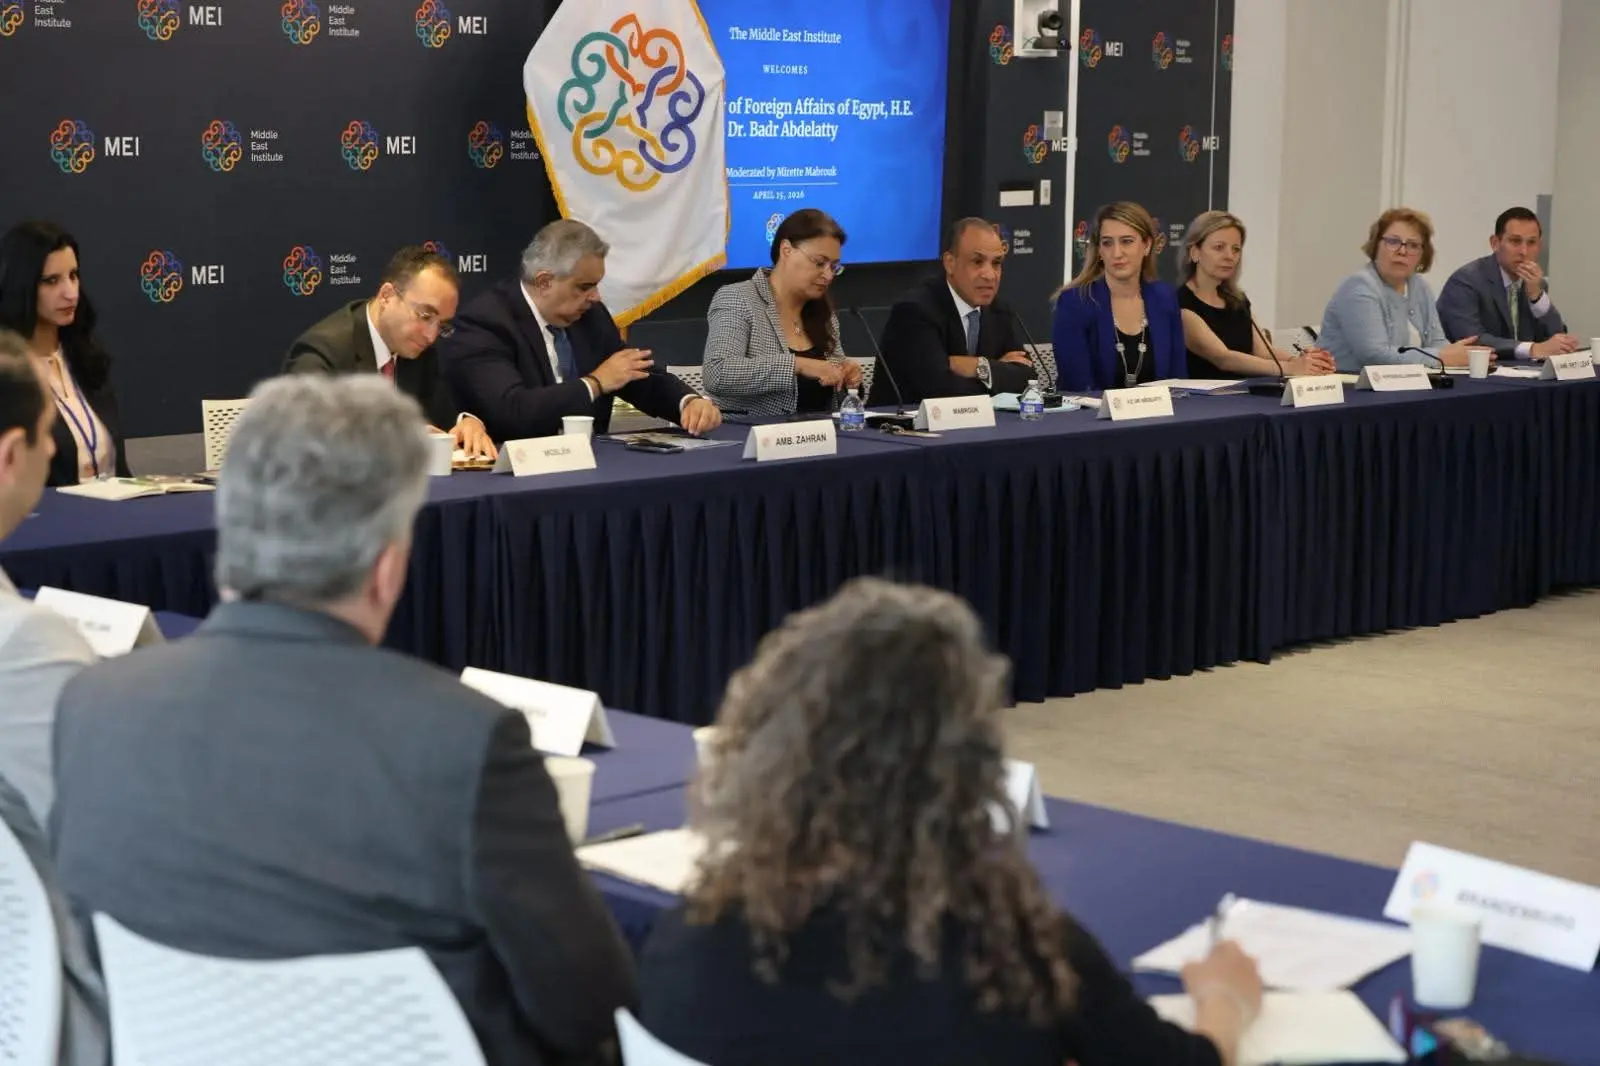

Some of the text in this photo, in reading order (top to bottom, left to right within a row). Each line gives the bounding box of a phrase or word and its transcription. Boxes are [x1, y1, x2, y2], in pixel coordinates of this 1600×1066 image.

[34, 5, 54, 15] East
[328, 5, 355, 15] Middle
[189, 6, 222, 26] MEI
[328, 16, 346, 26] East
[34, 18, 72, 28] Institute
[458, 16, 488, 35] MEI
[328, 27, 360, 37] Institute
[729, 26, 842, 44] The Middle East Institute
[1105, 42, 1124, 57] MEI
[762, 64, 808, 75] WELCOMES
[728, 97, 914, 121] of Foreign Affairs of Egypt, H.E.
[250, 130, 279, 139] Middle
[727, 120, 839, 142] Dr. Badr Abdelatty
[104, 136, 140, 157] MEI
[250, 142, 269, 151] East
[386, 136, 416, 155] MEI
[510, 140, 526, 150] East
[1202, 136, 1220, 151] MEI
[250, 152, 284, 162] Institute
[510, 150, 539, 160] Institute
[725, 165, 838, 179] Moderated by Mirette Mabrouk
[752, 190, 774, 200] APRIL
[329, 254, 357, 264] Middle
[458, 255, 488, 273] MEI
[329, 264, 347, 274] East
[191, 265, 225, 285] MEI
[329, 275, 361, 286] Institute
[775, 433, 827, 446] AMB. ZAHRAN
